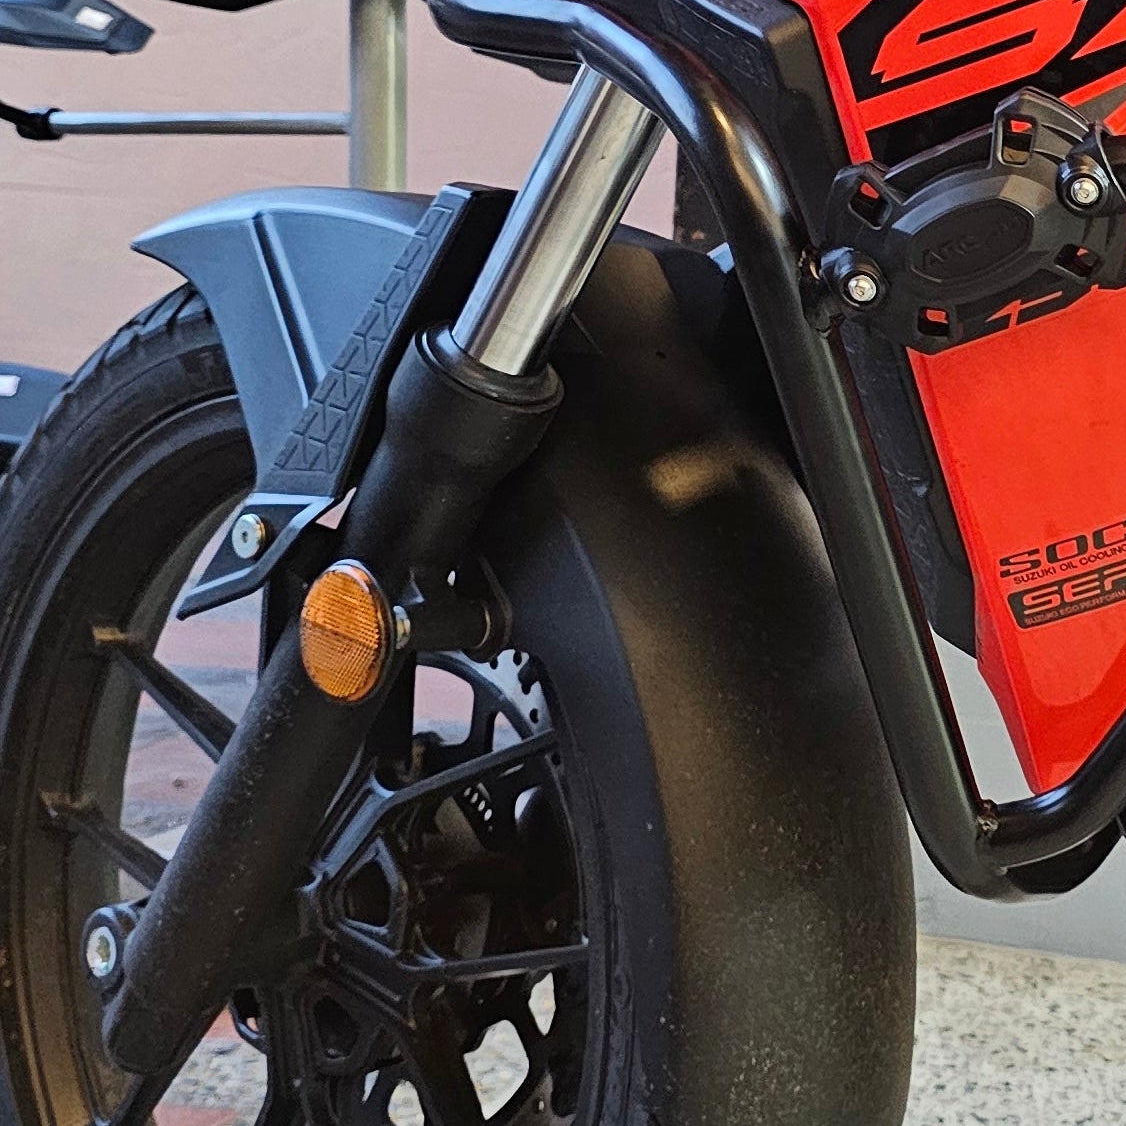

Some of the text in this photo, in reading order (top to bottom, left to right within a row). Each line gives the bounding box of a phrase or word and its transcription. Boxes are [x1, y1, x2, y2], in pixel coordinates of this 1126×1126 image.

[1013, 566, 1057, 585] SUZUKI
[1059, 561, 1078, 572] OIL
[1024, 609, 1060, 626] SUZUKI
[1060, 604, 1080, 616] ECO
